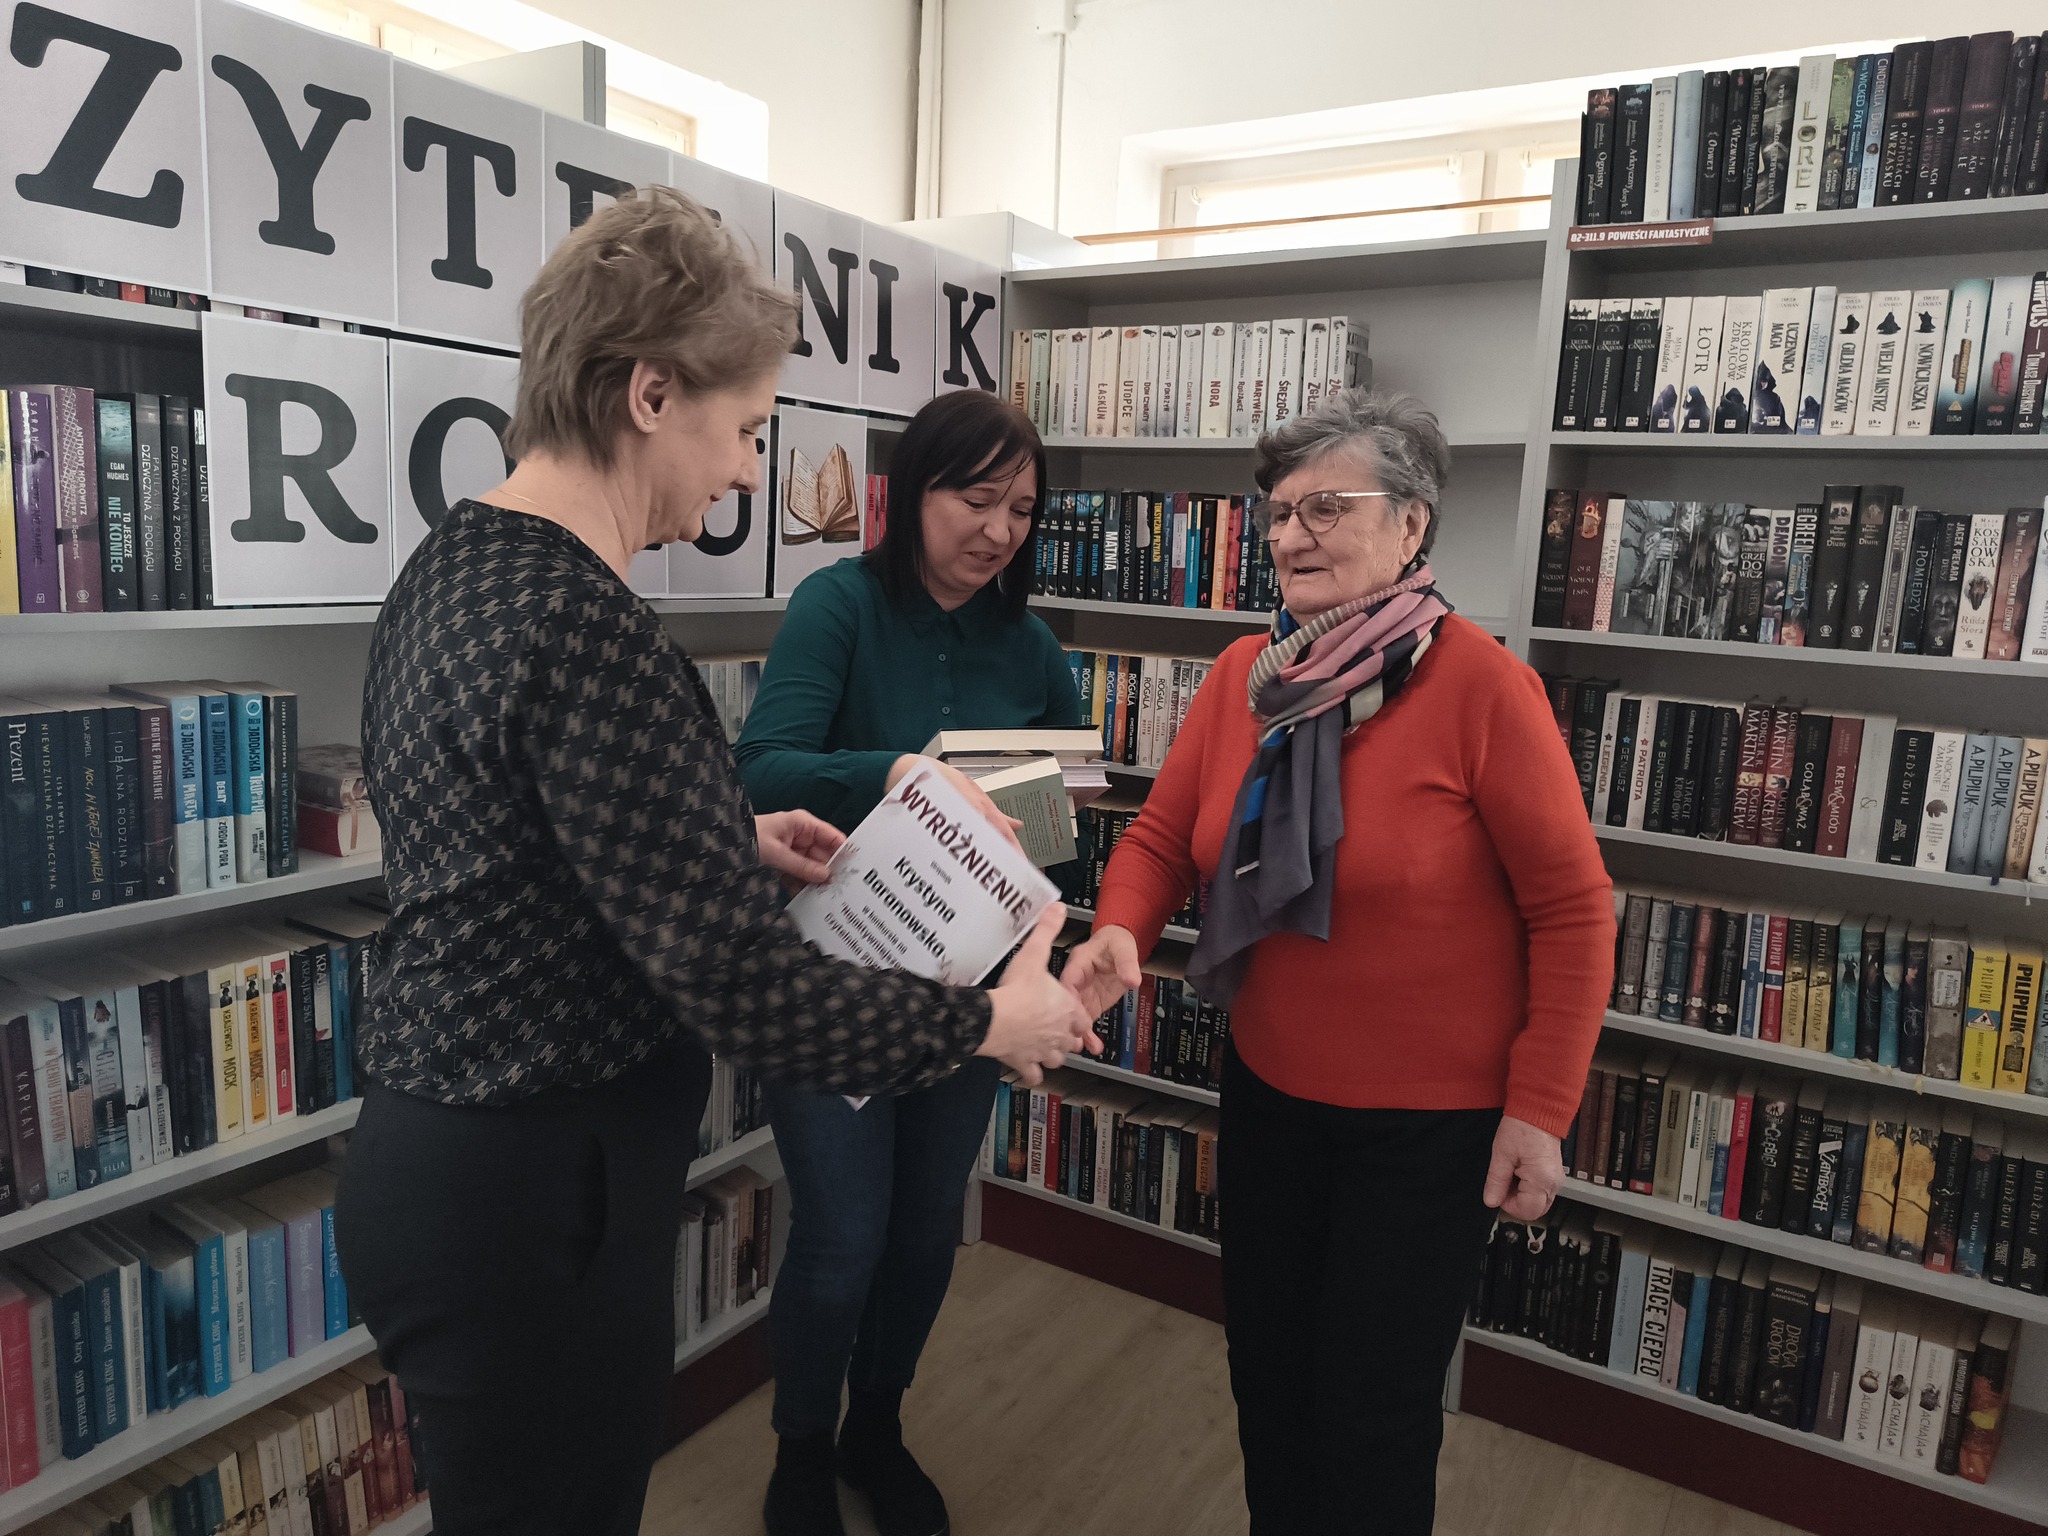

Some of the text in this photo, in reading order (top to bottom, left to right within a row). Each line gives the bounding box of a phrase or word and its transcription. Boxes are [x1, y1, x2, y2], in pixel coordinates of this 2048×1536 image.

[1852, 70, 1868, 129] WICKED FATE
[1871, 58, 1889, 109] CINDERELLA
[1794, 101, 1818, 189] LORE
[1882, 131, 1899, 188] WRZASKU
[1570, 225, 1710, 243] 82-311.9 POWIEŚCI FANTASTYCZNE
[150, 287, 171, 298] FILIA
[2029, 280, 2046, 328] IMPULS
[1694, 326, 1713, 374] ŁOTR
[1726, 321, 1742, 381] ZDRAJCÓW
[1735, 321, 1753, 381] KRÓLOWA
[1769, 322, 1784, 349] MAGA
[1781, 322, 1800, 375] UCZENNICA
[1121, 380, 1134, 418] UTOPCE
[1209, 380, 1221, 408] NORA
[1833, 342, 1856, 413] GILDIA MAGÓW
[1872, 340, 1896, 412] WIELKI MISTRZ
[1910, 343, 1935, 411] NOWICJUSZKA
[30, 401, 40, 443] SARAH
[1096, 382, 1108, 420] ŁASKUN
[1251, 379, 1264, 424] MARTWIEC
[1275, 380, 1291, 422] ŚREŻOGA
[75, 424, 88, 516] ANTHONY HOROWITZ
[106, 472, 130, 481] HUGHES
[110, 462, 125, 471] EGAN
[141, 444, 156, 573] DZIEWCZYNA Z POCIĄGU
[170, 445, 183, 572] DZIEWCZYNA Z POCIĄGU
[1973, 528, 2000, 537] KOS
[107, 496, 124, 574] NIE KONIEC
[122, 512, 133, 559] TO JESZCZE
[1061, 541, 1070, 574] DYLEMAT
[1104, 531, 1119, 571] MATNIA
[1124, 524, 1132, 554] ZOSTAŃ
[1771, 516, 1791, 568] DEMON
[1793, 514, 1818, 553] GREEN
[1949, 522, 1966, 582] JACEK PIEKARA
[1970, 547, 1996, 557] OW
[1971, 537, 1998, 547] SAK
[1124, 556, 1130, 565] W
[1741, 561, 1762, 571] DO
[1968, 558, 1996, 567] SKA
[1081, 667, 1091, 700] ROGALA
[1106, 670, 1115, 704] ROGALA
[1116, 671, 1126, 705] ROGALA
[1126, 673, 1137, 706] ROGALA
[1142, 676, 1152, 710] ROGALA
[1156, 678, 1166, 711] ROGALA
[83, 716, 92, 758] LISA JEWELL
[247, 726, 261, 772] JADOWSKA
[1742, 709, 1761, 767] MARTIN
[1759, 709, 1770, 747] GEORGE
[1770, 710, 1789, 770] MARTIN
[8, 721, 27, 784] Prezent
[150, 717, 164, 801] OKRUTNE PRAGNIENIE
[182, 731, 196, 779] JADOWSKA
[211, 734, 227, 804] JADOWSKA DENAT
[1598, 745, 1611, 794] LEGENDA
[1616, 747, 1630, 793] GENIUSZ
[1633, 749, 1647, 801] PATRIOTA
[1900, 736, 1919, 806] WIEDŹMIN
[1963, 744, 1986, 806] A.PILIPIUK
[1651, 751, 1667, 815] BUNTOWNIK
[1827, 765, 1847, 834] KREW MIÓD
[1990, 746, 2014, 809] A.PILIPIUK
[2018, 748, 2041, 810] A.PILIPIUK
[41, 723, 57, 890] NIEWIDZIALNA DZIEWCZYNA
[57, 800, 65, 835] JEWELL
[114, 739, 127, 868] IDEALNA RODZINA
[281, 771, 290, 854] NIEWYBACZALNE
[1733, 787, 1749, 829] KREW
[1761, 789, 1777, 831] KREW
[900, 782, 1034, 922] WYRÓŻNIENIE
[862, 867, 948, 958] Baranowska
[893, 855, 957, 925] Krystyna
[1749, 928, 1763, 963] PILIPIUK
[1769, 931, 1783, 966] PILIPIUK
[303, 960, 312, 1023] KRAJEWSKI
[1978, 967, 1995, 1005] PILIPIUK
[2009, 962, 2034, 1037] PILIPIUK
[222, 1008, 238, 1091] KRAJEWSKI MOCK
[249, 1001, 264, 1081] KRAJEWSKI MOCK
[1177, 1028, 1189, 1065] WAKACJE
[15, 1070, 35, 1140] KAPŁAN
[103, 1161, 126, 1174] FILIA
[1030, 1126, 1043, 1176] TRZECIA SZANSA
[1138, 1128, 1147, 1161] WARDA
[1198, 1139, 1210, 1194] POD KLUCZEM
[2000, 1163, 2016, 1229] WIEDŹMIN
[2028, 1169, 2045, 1235] WIEDŹMIN
[1775, 1286, 1806, 1299] BRANDON
[1639, 1265, 1673, 1377] TRACĘ CIEPŁO
[1783, 1322, 1802, 1368] DROGA
[105, 1358, 114, 1384] KING
[213, 1320, 223, 1384] STEPHEN KING
[76, 1369, 89, 1437] STEPHEN KING
[106, 1386, 117, 1425] STEPHEN
[1857, 1394, 1869, 1434] ACHAJA
[1885, 1400, 1900, 1442] ACHAJA
[1915, 1410, 1931, 1451] ACHAJA
